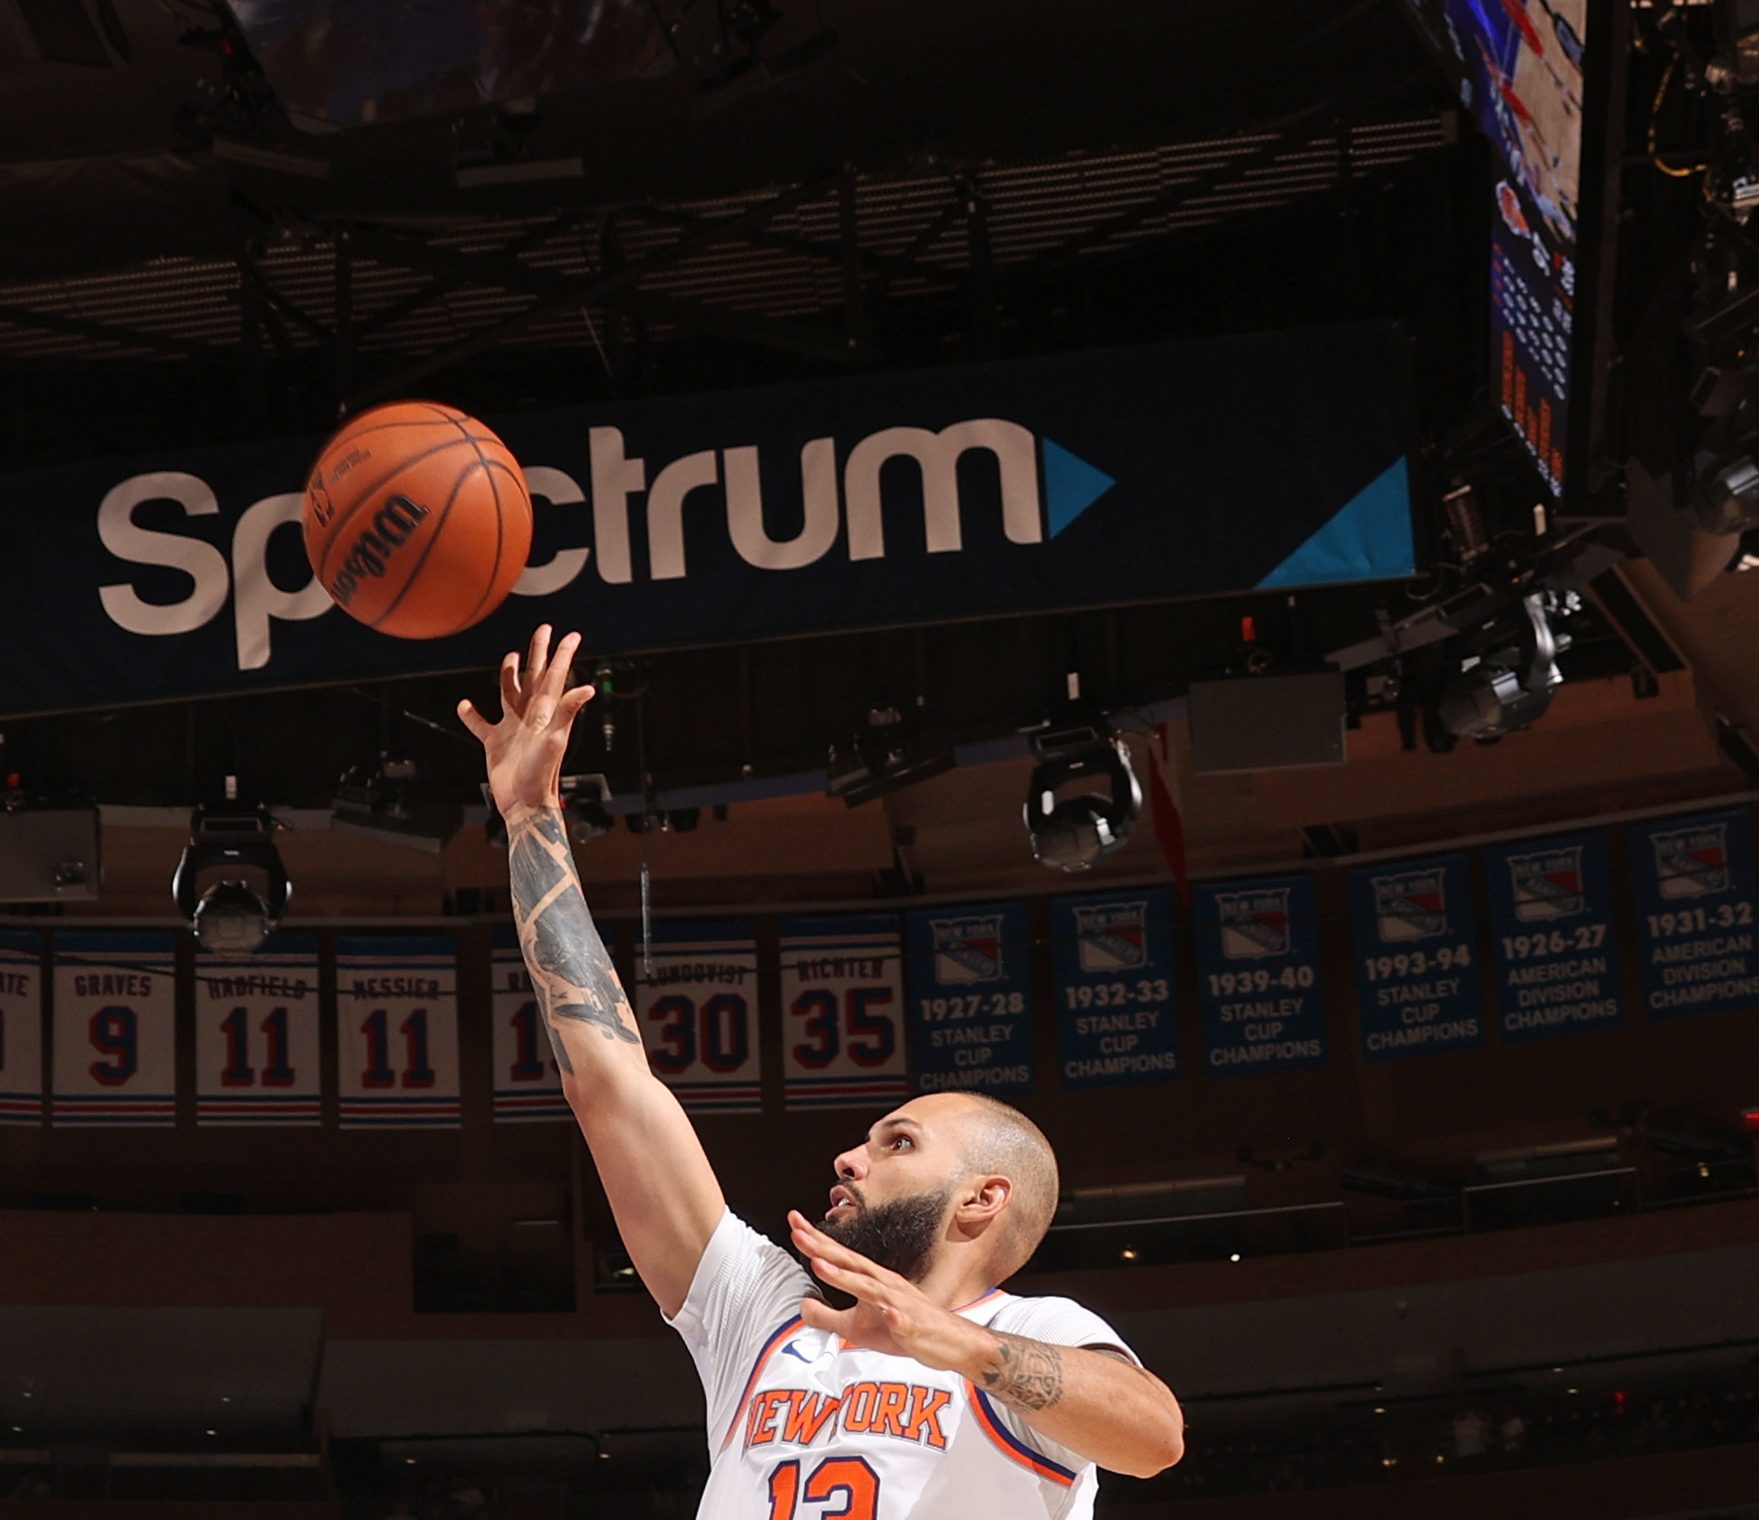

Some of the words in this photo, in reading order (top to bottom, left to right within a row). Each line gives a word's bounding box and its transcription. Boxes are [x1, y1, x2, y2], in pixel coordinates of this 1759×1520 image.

[97, 418, 1043, 670] Spctrum
[1647, 901, 1753, 938] 1931-32
[1502, 923, 1607, 961] 1926-27
[1652, 935, 1752, 965] AMERICAN
[798, 958, 883, 982] RICHTER
[1365, 943, 1471, 982] 1993-94
[1507, 956, 1607, 988] AMERICAN
[1663, 957, 1747, 986] DIVISION
[75, 974, 152, 997] GRAVES
[207, 975, 307, 999] HADFIELD
[353, 977, 439, 1000] MESSIER
[1065, 978, 1170, 1010] 1932-33
[1208, 965, 1314, 997] 1939-40
[1376, 977, 1461, 1007] STANLEY
[1518, 979, 1600, 1007] DIVISION
[1650, 976, 1759, 1010] CHAMPIONS
[920, 991, 1025, 1022] 1927-28
[1219, 997, 1304, 1023] STANLEY
[1401, 1002, 1441, 1025] CUP
[1504, 998, 1618, 1031] CHAMPIONS
[649, 994, 747, 1074] 30
[791, 987, 894, 1069] 35
[931, 1024, 1014, 1047] STANLEY
[1076, 1011, 1160, 1035] STANLEY
[1243, 1020, 1284, 1041] CUP
[1366, 1017, 1480, 1051] CHAMPIONS
[89, 1006, 137, 1086] 9
[220, 1007, 295, 1087] 11
[360, 1008, 435, 1089] 11
[511, 1001, 546, 1082] 1
[954, 1046, 992, 1067] CUP
[1100, 1034, 1140, 1054] CUP
[1209, 1038, 1322, 1067] CHAMPIONS
[919, 1064, 1029, 1090] CHAMPIONS
[1065, 1051, 1177, 1079] CHAMPIONS
